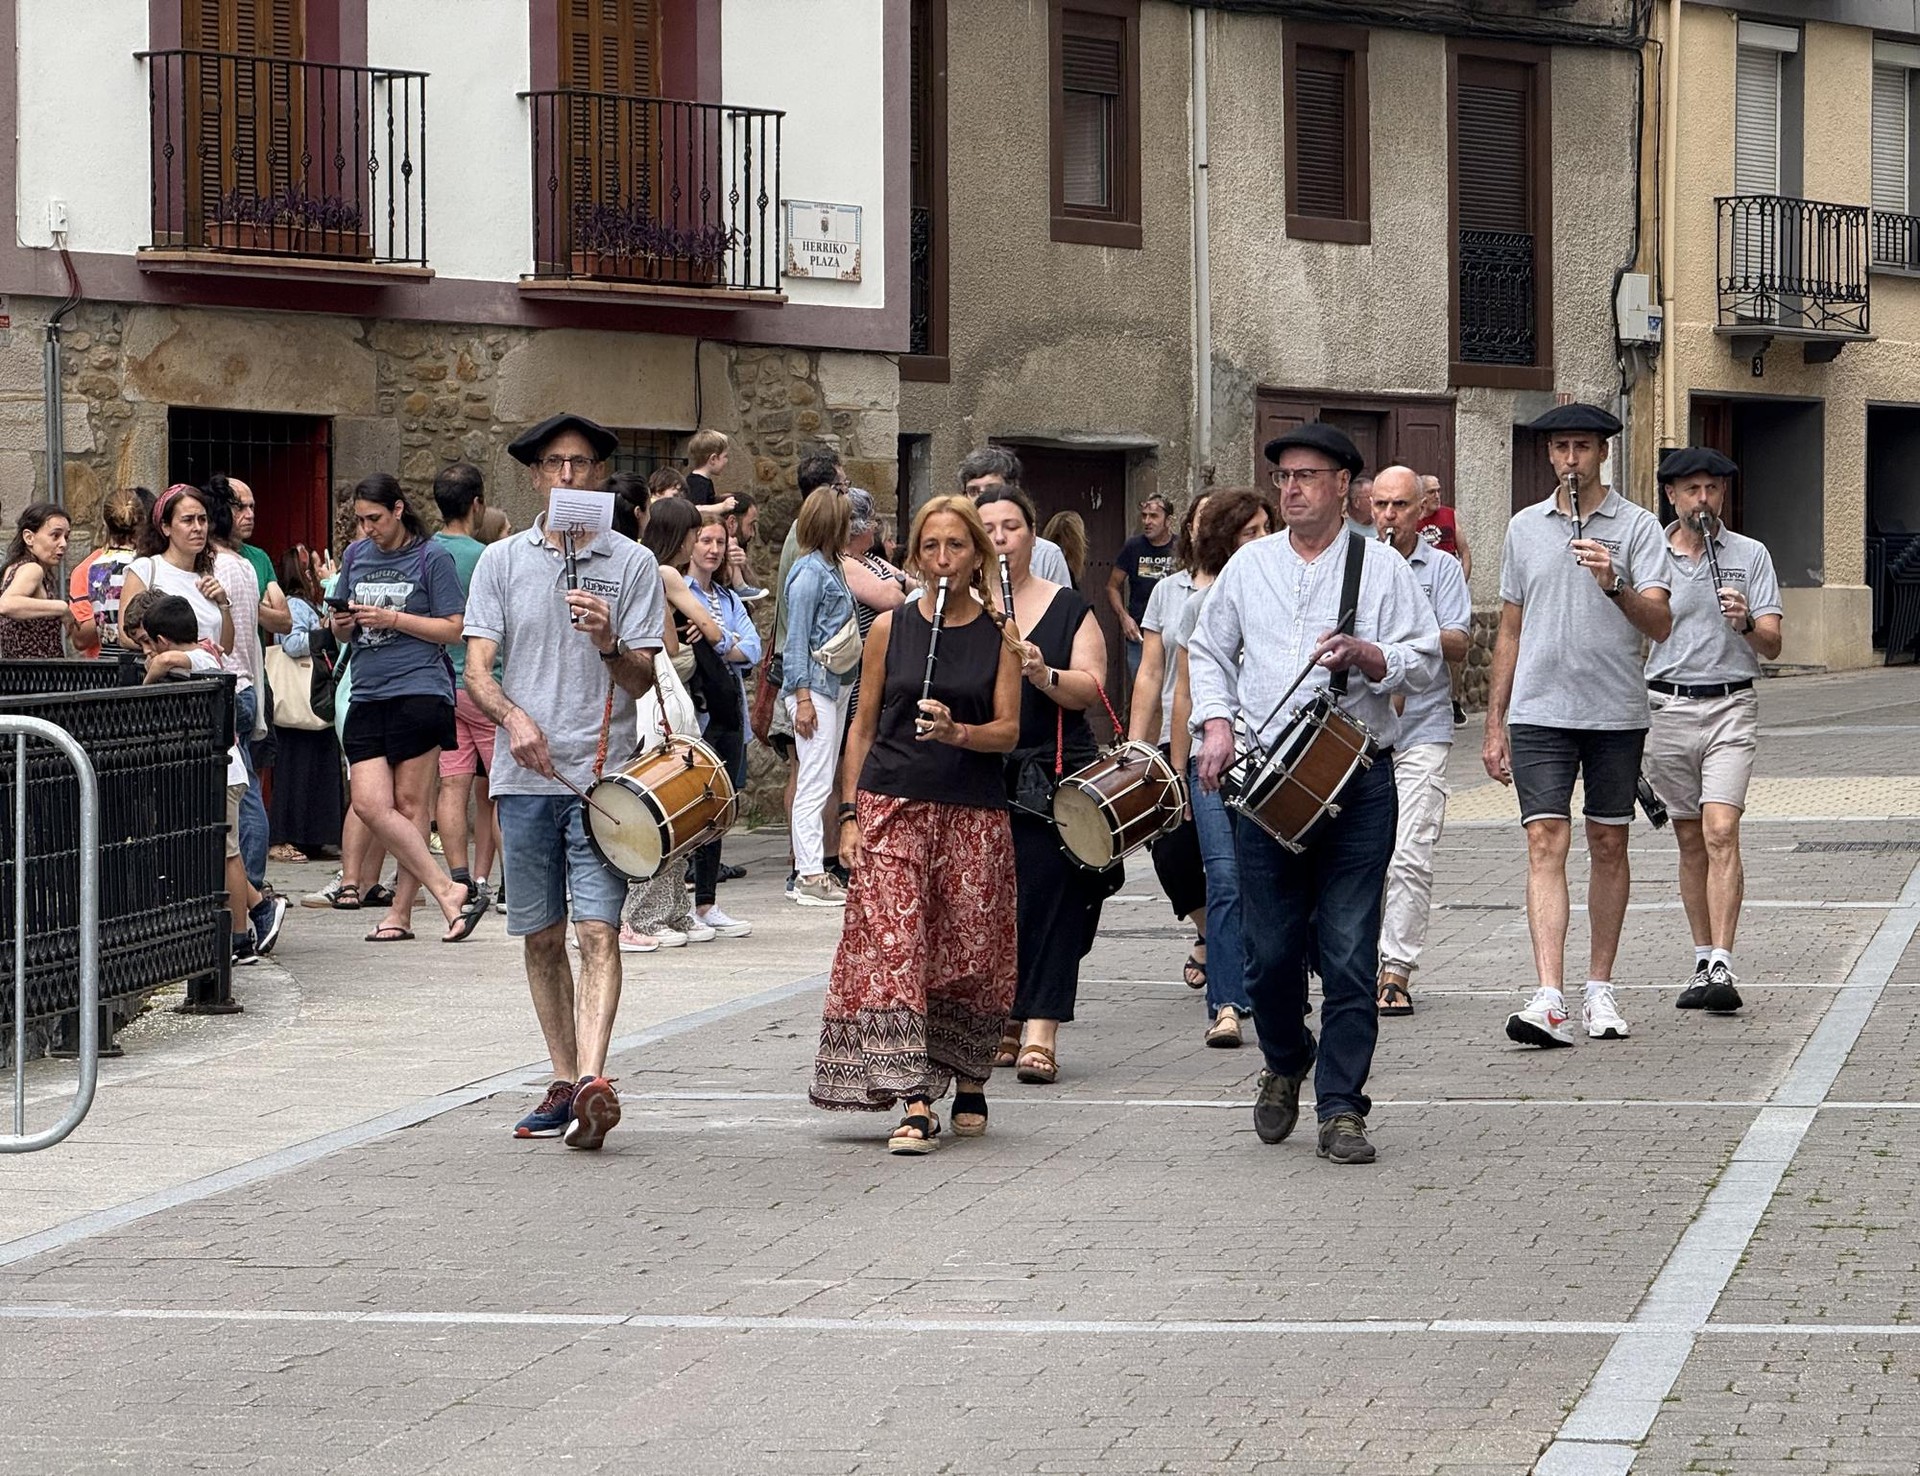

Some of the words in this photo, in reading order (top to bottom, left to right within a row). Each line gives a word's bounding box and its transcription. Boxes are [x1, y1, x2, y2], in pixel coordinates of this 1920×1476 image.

[802, 240, 847, 255] HERRIKO
[809, 255, 840, 268] PLAZA
[1755, 359, 1761, 375] 3
[1139, 556, 1173, 564] DELORE
